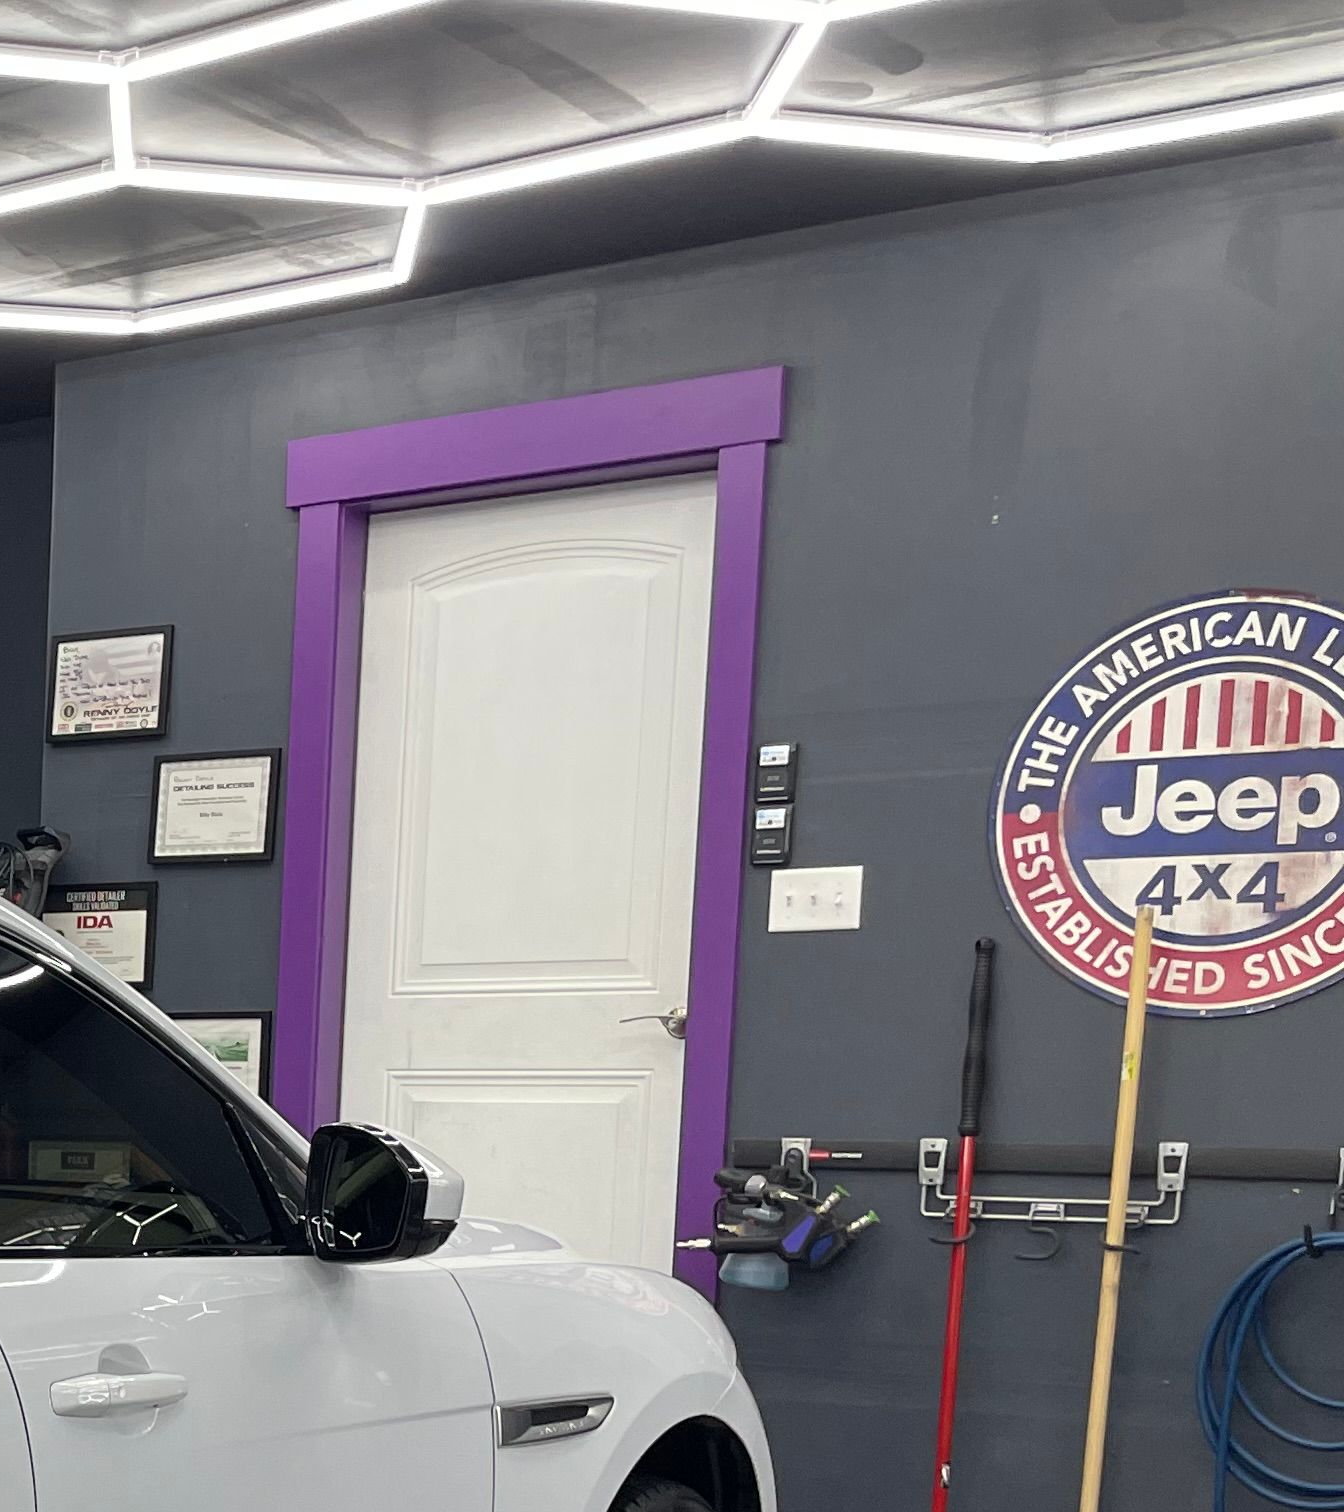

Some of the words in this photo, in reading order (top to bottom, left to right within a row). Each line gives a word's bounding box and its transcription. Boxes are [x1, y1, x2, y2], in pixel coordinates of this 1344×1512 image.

[1017, 715, 1079, 792] THE
[1071, 610, 1307, 719] AMERICAN
[1101, 765, 1341, 846] Jeep
[96, 889, 126, 902] DETAILER
[76, 915, 113, 929] IDA
